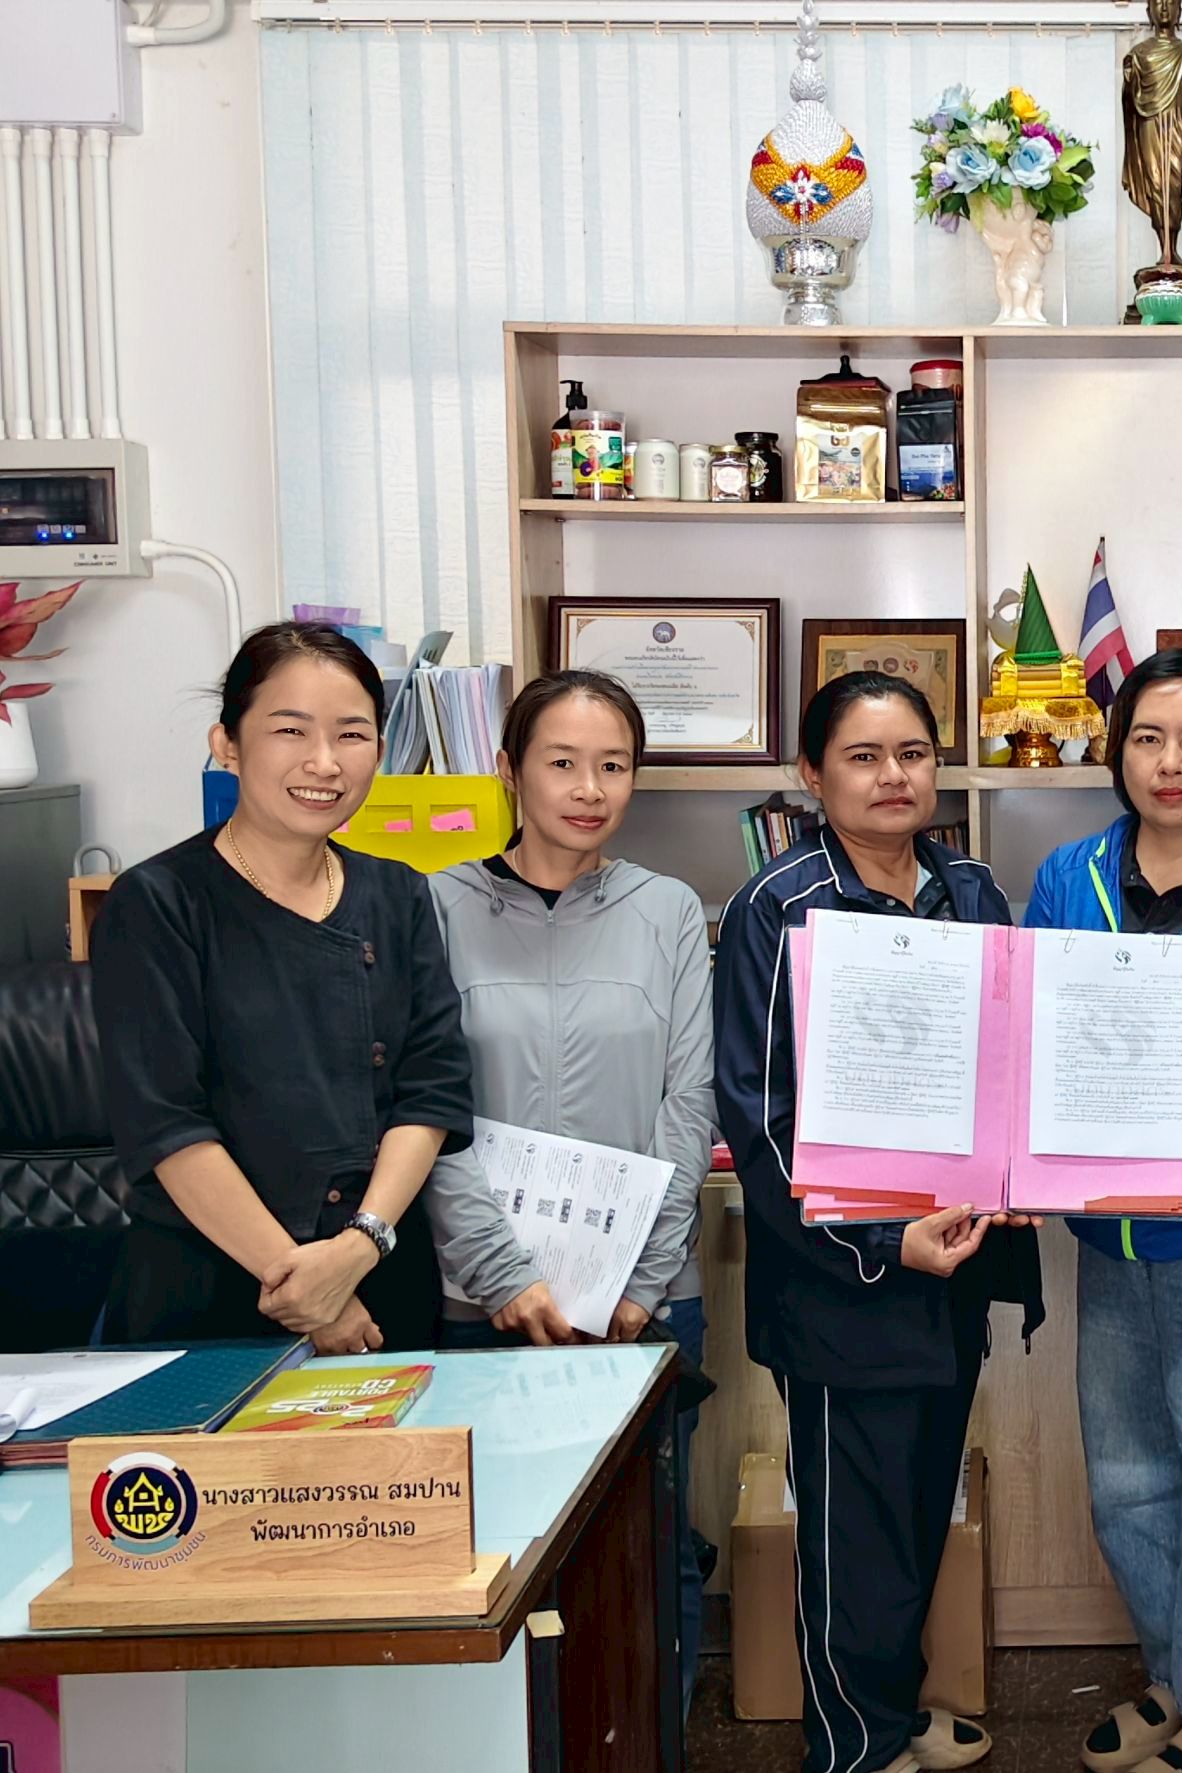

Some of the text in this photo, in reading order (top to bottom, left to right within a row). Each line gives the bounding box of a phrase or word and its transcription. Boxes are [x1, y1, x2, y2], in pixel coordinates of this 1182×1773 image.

[202, 1477, 461, 1506] นางสาวแสงวรรณ สมปาน
[250, 1515, 415, 1542] พัฒนาการอำเภอ
[85, 1531, 208, 1571] กรมการพัฒนาชุมชน
